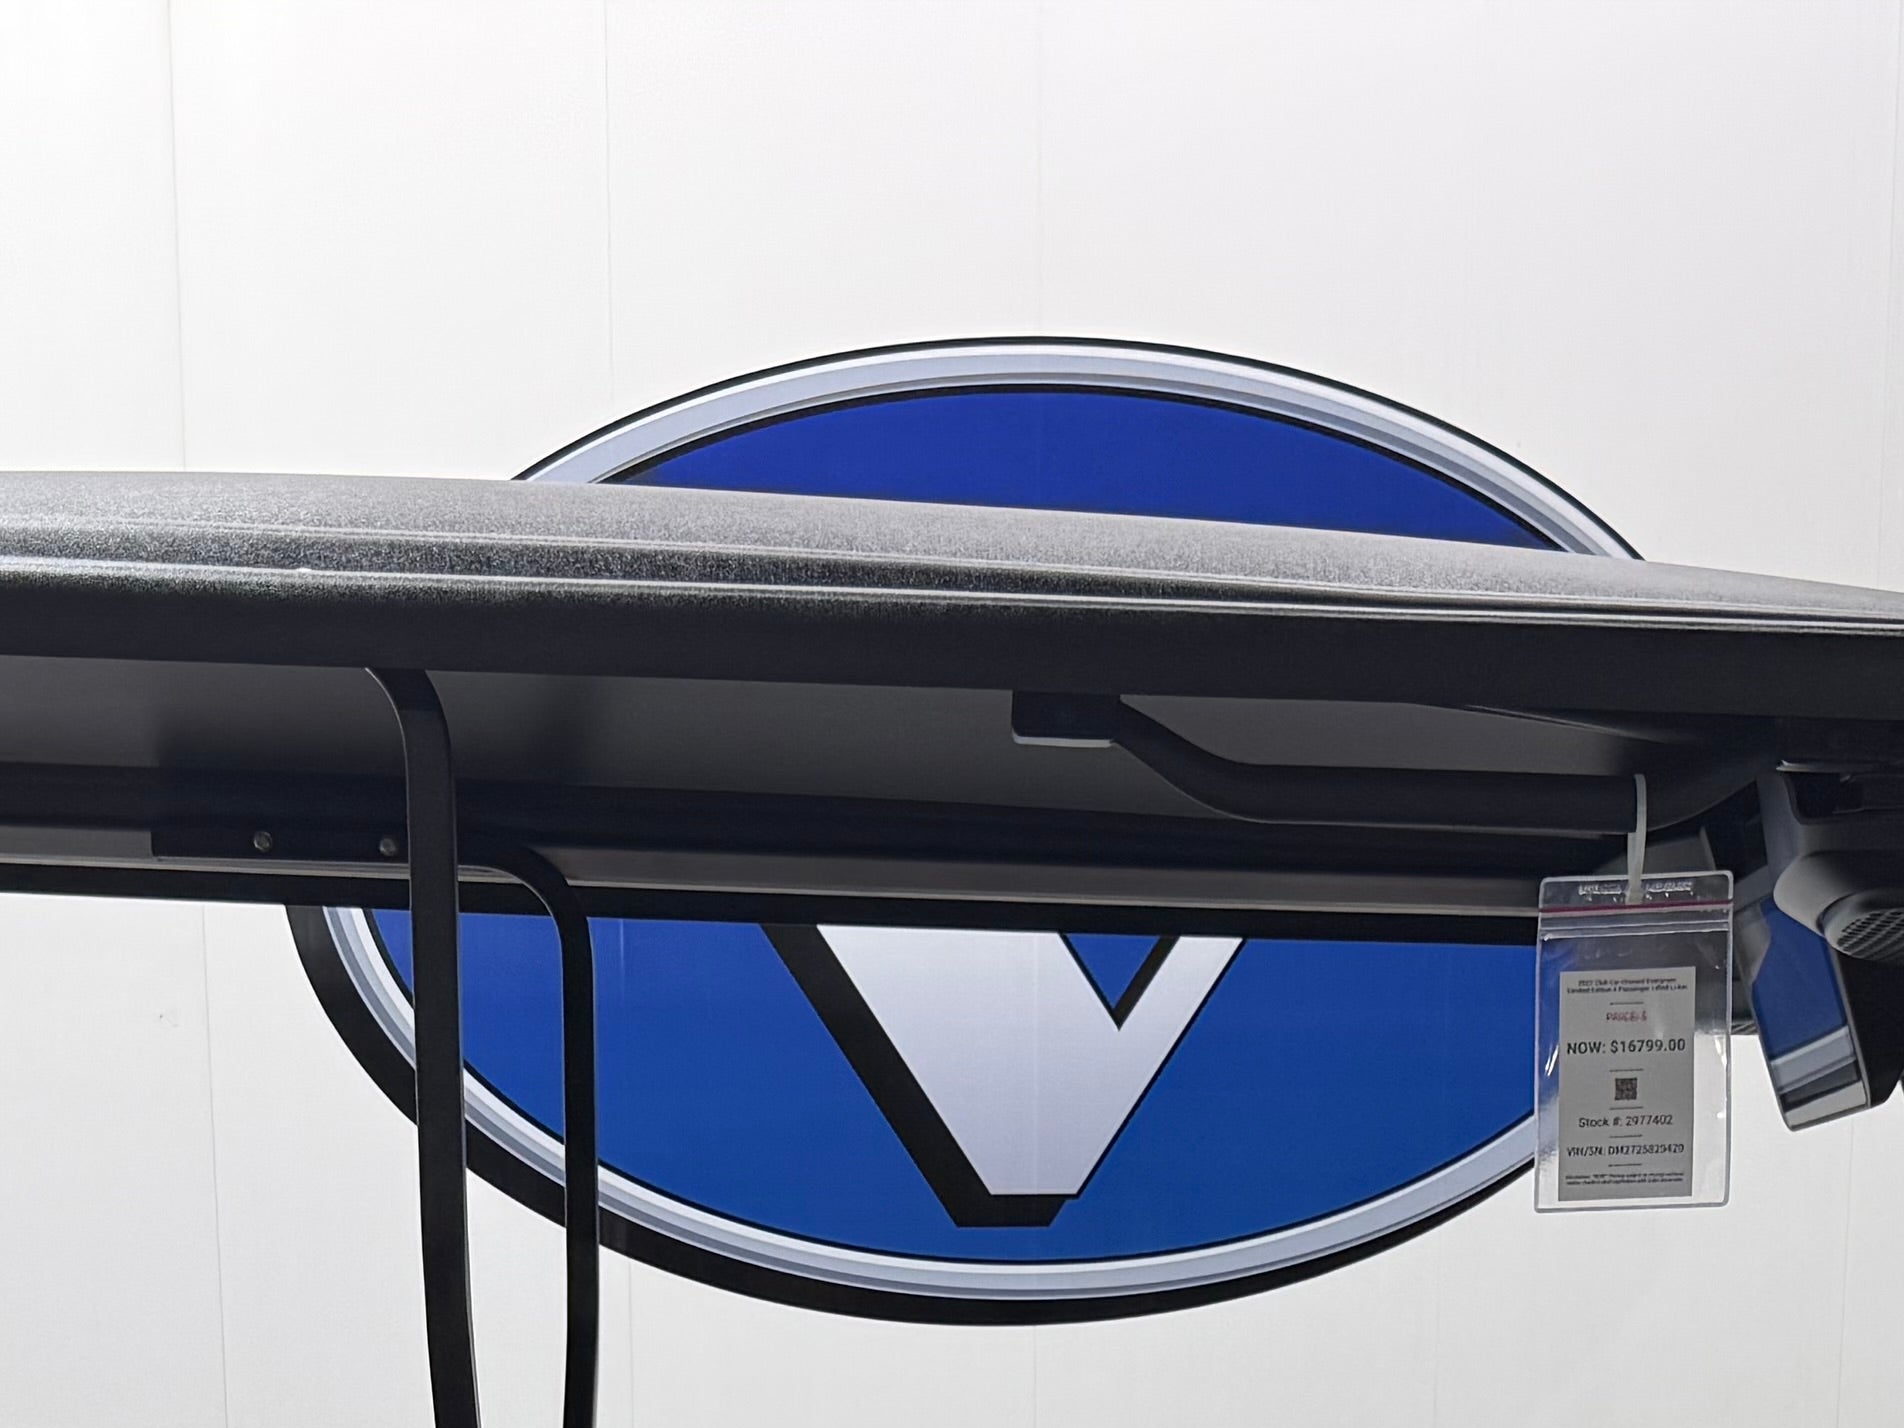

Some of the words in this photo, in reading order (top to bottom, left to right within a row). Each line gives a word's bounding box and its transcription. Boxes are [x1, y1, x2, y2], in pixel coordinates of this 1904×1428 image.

[1567, 1041, 1606, 1054] NOW:
[1610, 1038, 1686, 1054] $16799.00
[1578, 1117, 1609, 1128] Stock
[1625, 1114, 1673, 1127] 2977402
